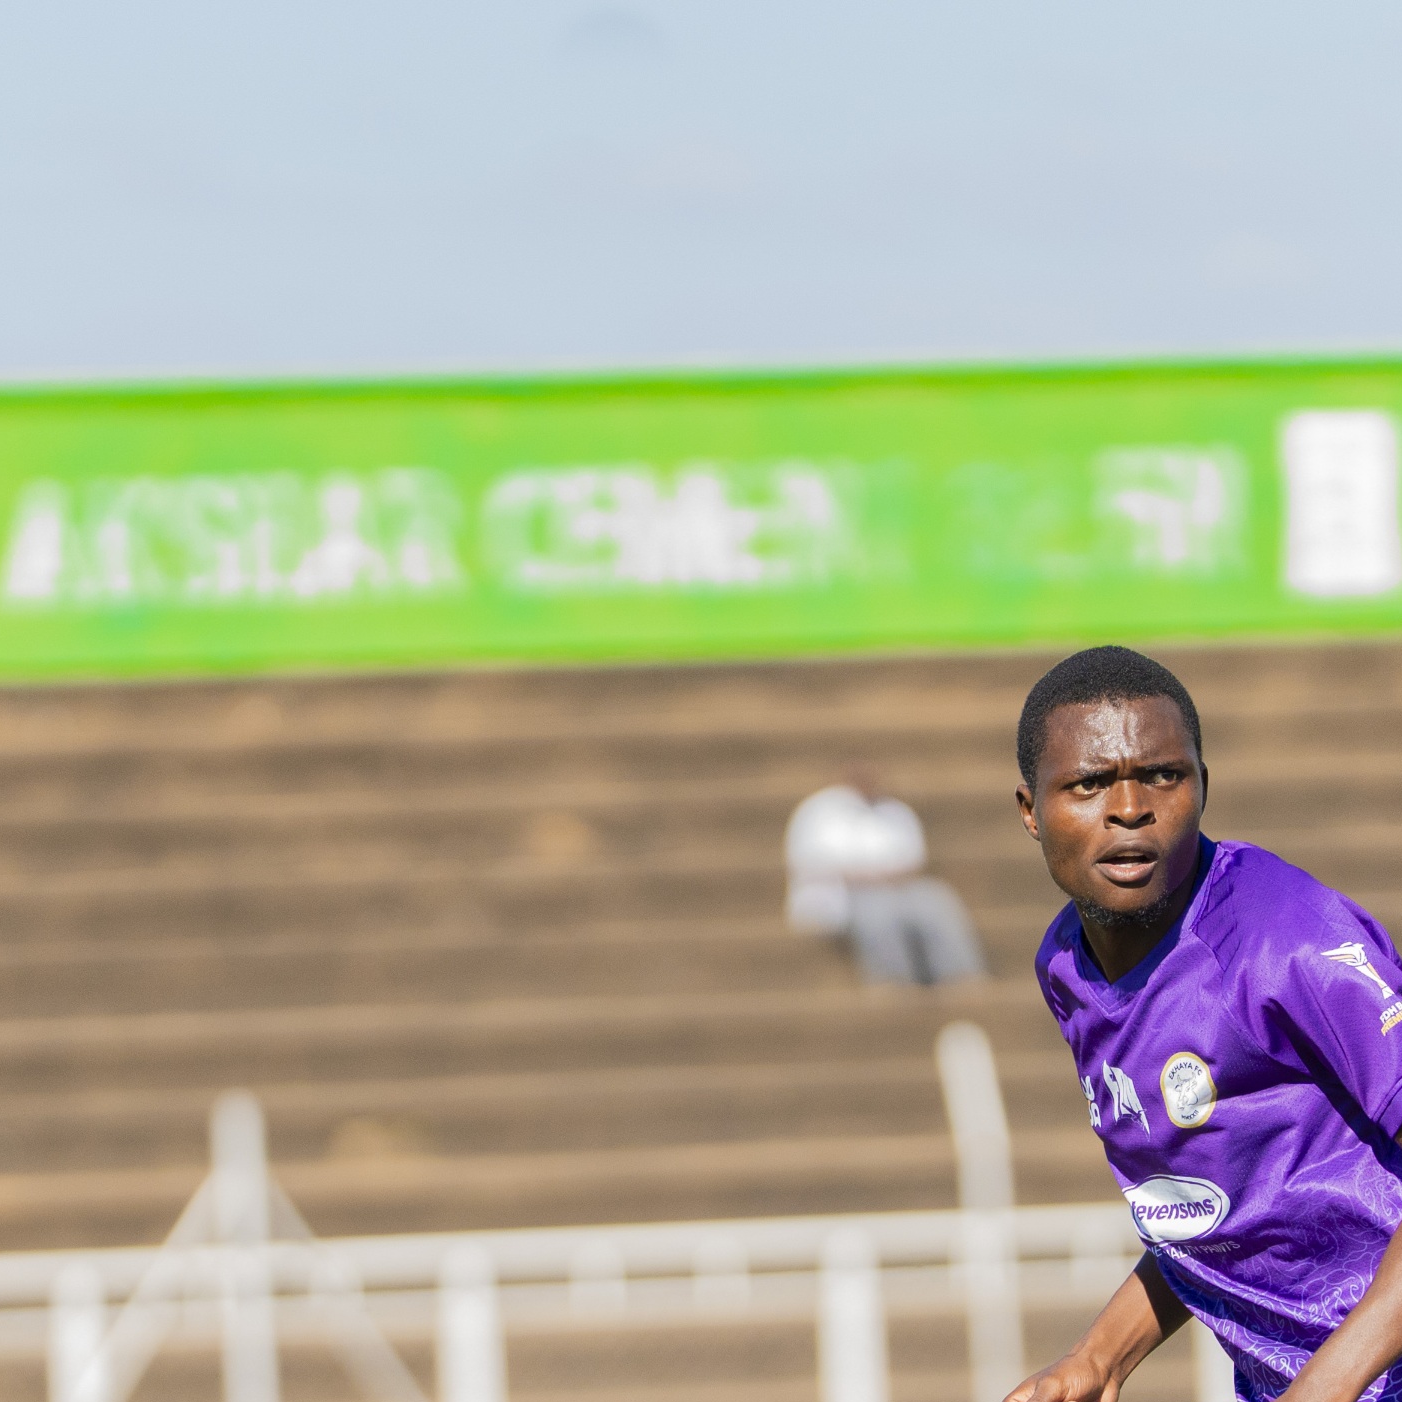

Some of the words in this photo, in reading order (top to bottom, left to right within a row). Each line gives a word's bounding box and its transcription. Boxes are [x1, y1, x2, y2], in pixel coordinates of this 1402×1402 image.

[1379, 1004, 1399, 1025] FDH
[1169, 1062, 1193, 1080] EKHAYA
[1194, 1064, 1203, 1076] FC
